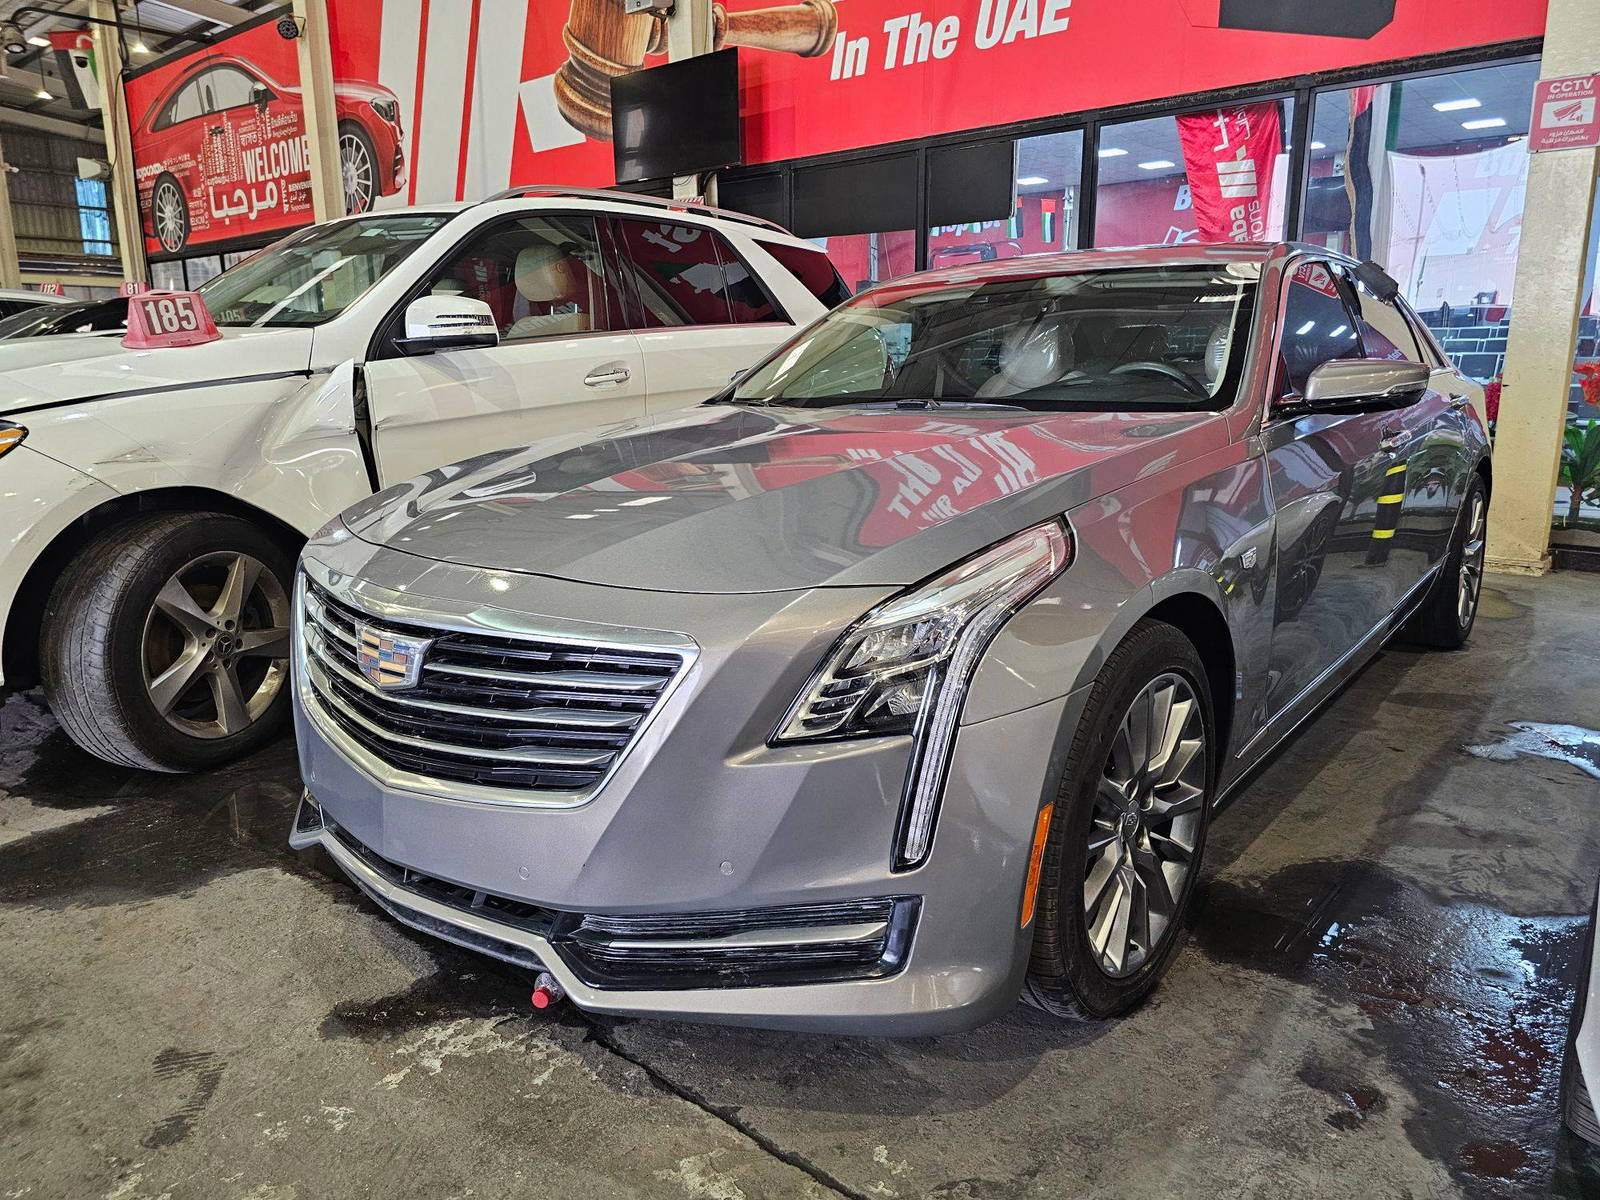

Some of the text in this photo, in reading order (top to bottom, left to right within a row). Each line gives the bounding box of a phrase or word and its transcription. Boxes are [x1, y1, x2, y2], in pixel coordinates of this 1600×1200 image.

[830, 0, 1072, 81] In The UAE
[1550, 78, 1595, 93] CCTV
[1556, 89, 1594, 98] OPERATION
[242, 135, 311, 184] WELCOME
[208, 181, 278, 225] مرحبا
[43, 284, 56, 294] 112
[126, 283, 139, 295] 81
[144, 297, 198, 335] 185
